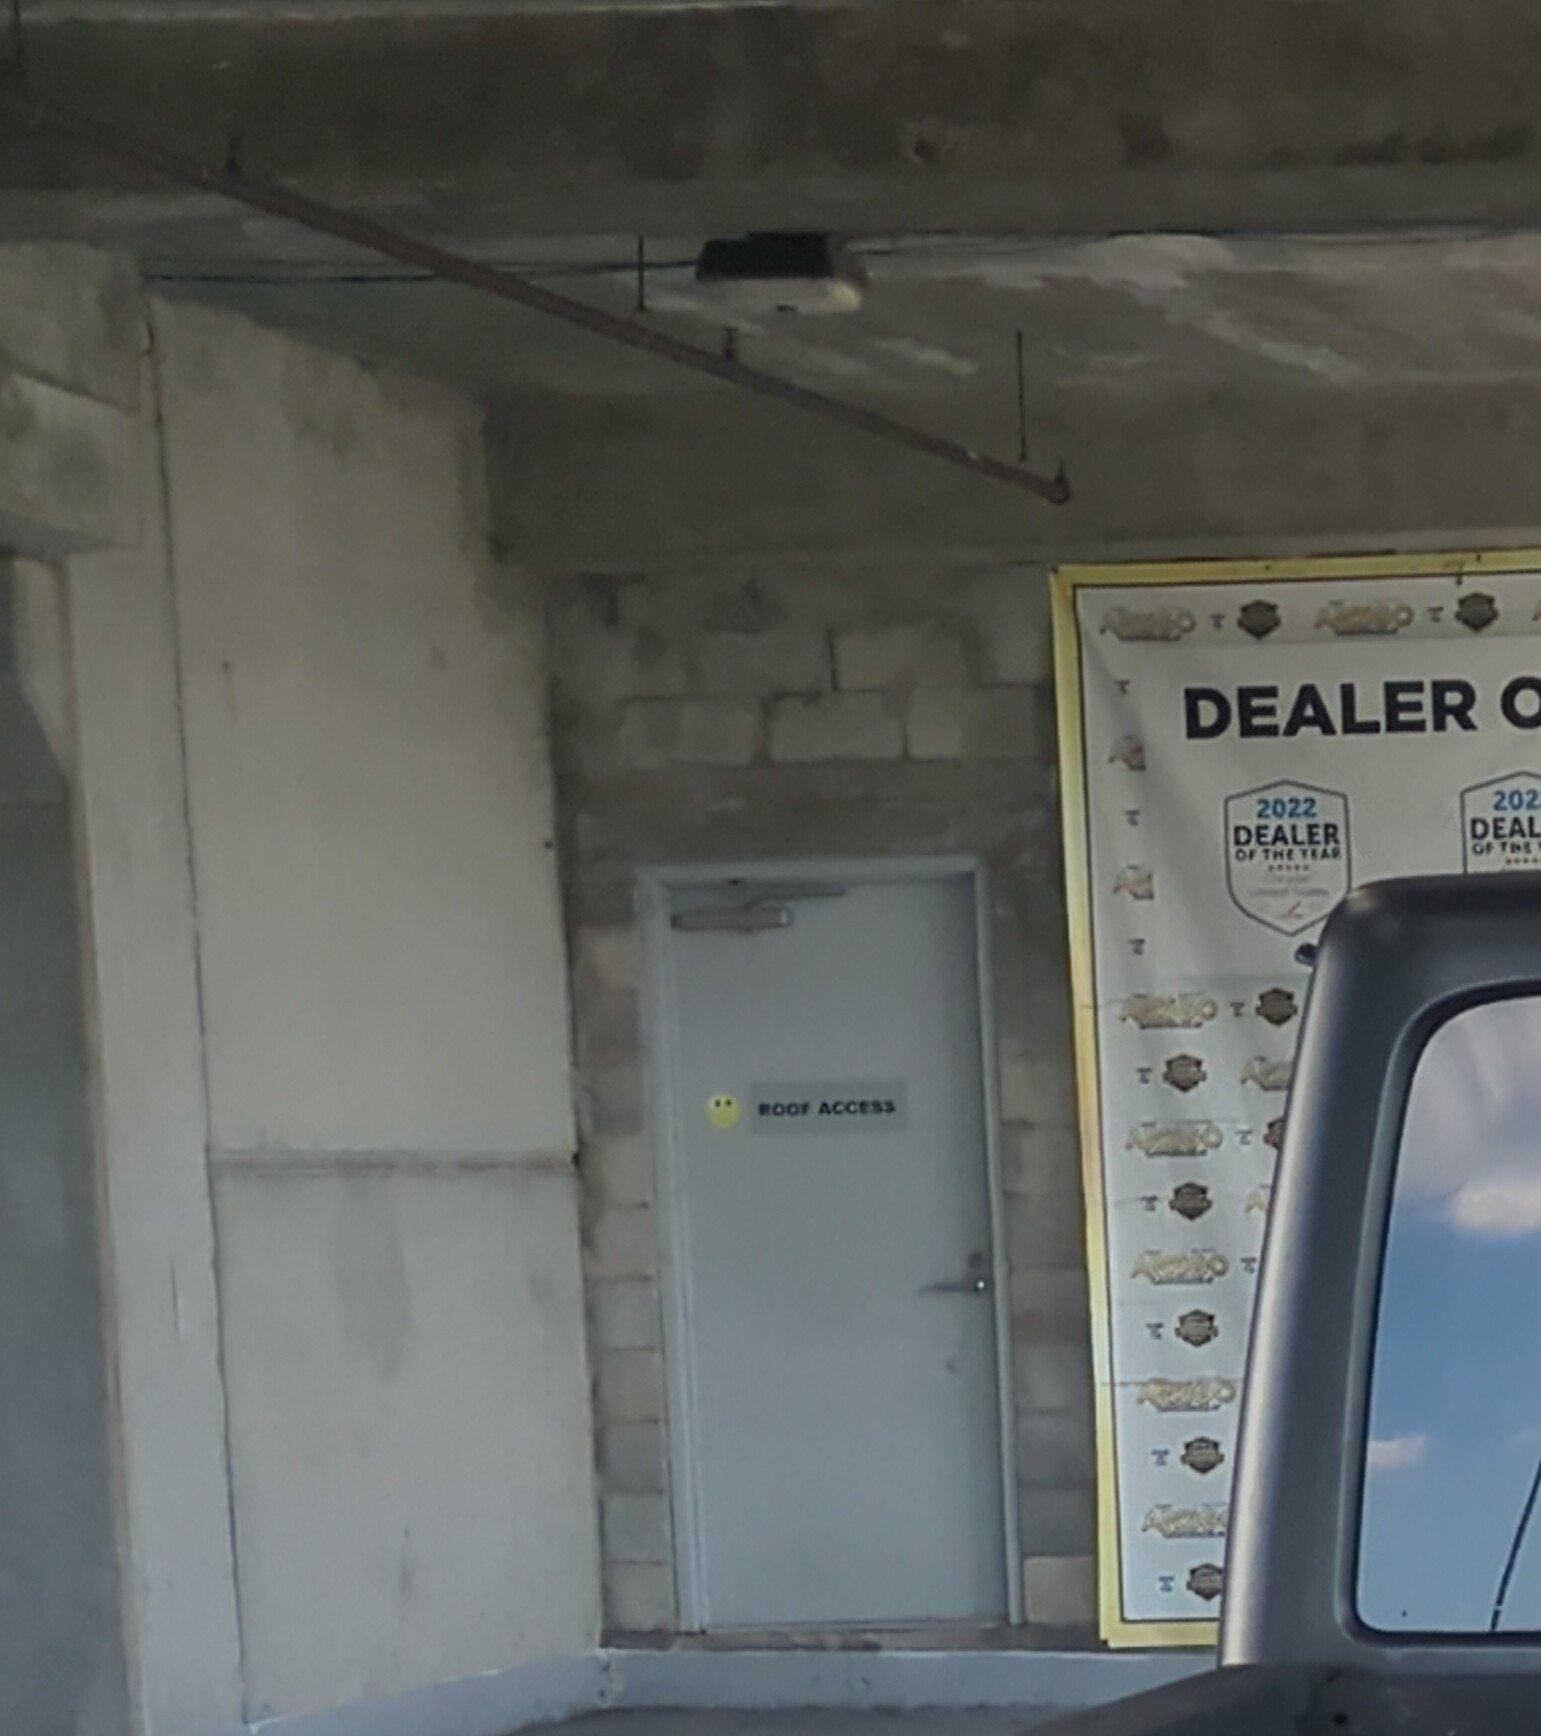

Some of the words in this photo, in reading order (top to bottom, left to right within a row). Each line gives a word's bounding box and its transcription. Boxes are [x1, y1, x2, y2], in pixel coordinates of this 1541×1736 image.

[1184, 679, 1478, 739] DEALER
[1257, 797, 1317, 819] 2022
[1234, 822, 1340, 846] DEALER
[1235, 849, 1256, 862] OF
[1264, 848, 1293, 861] THE
[1300, 847, 1341, 860] YEAR
[1472, 842, 1494, 855] OF
[1501, 841, 1532, 854] THE
[757, 1102, 810, 1117] ROOF
[818, 1100, 896, 1116] ACCESS
